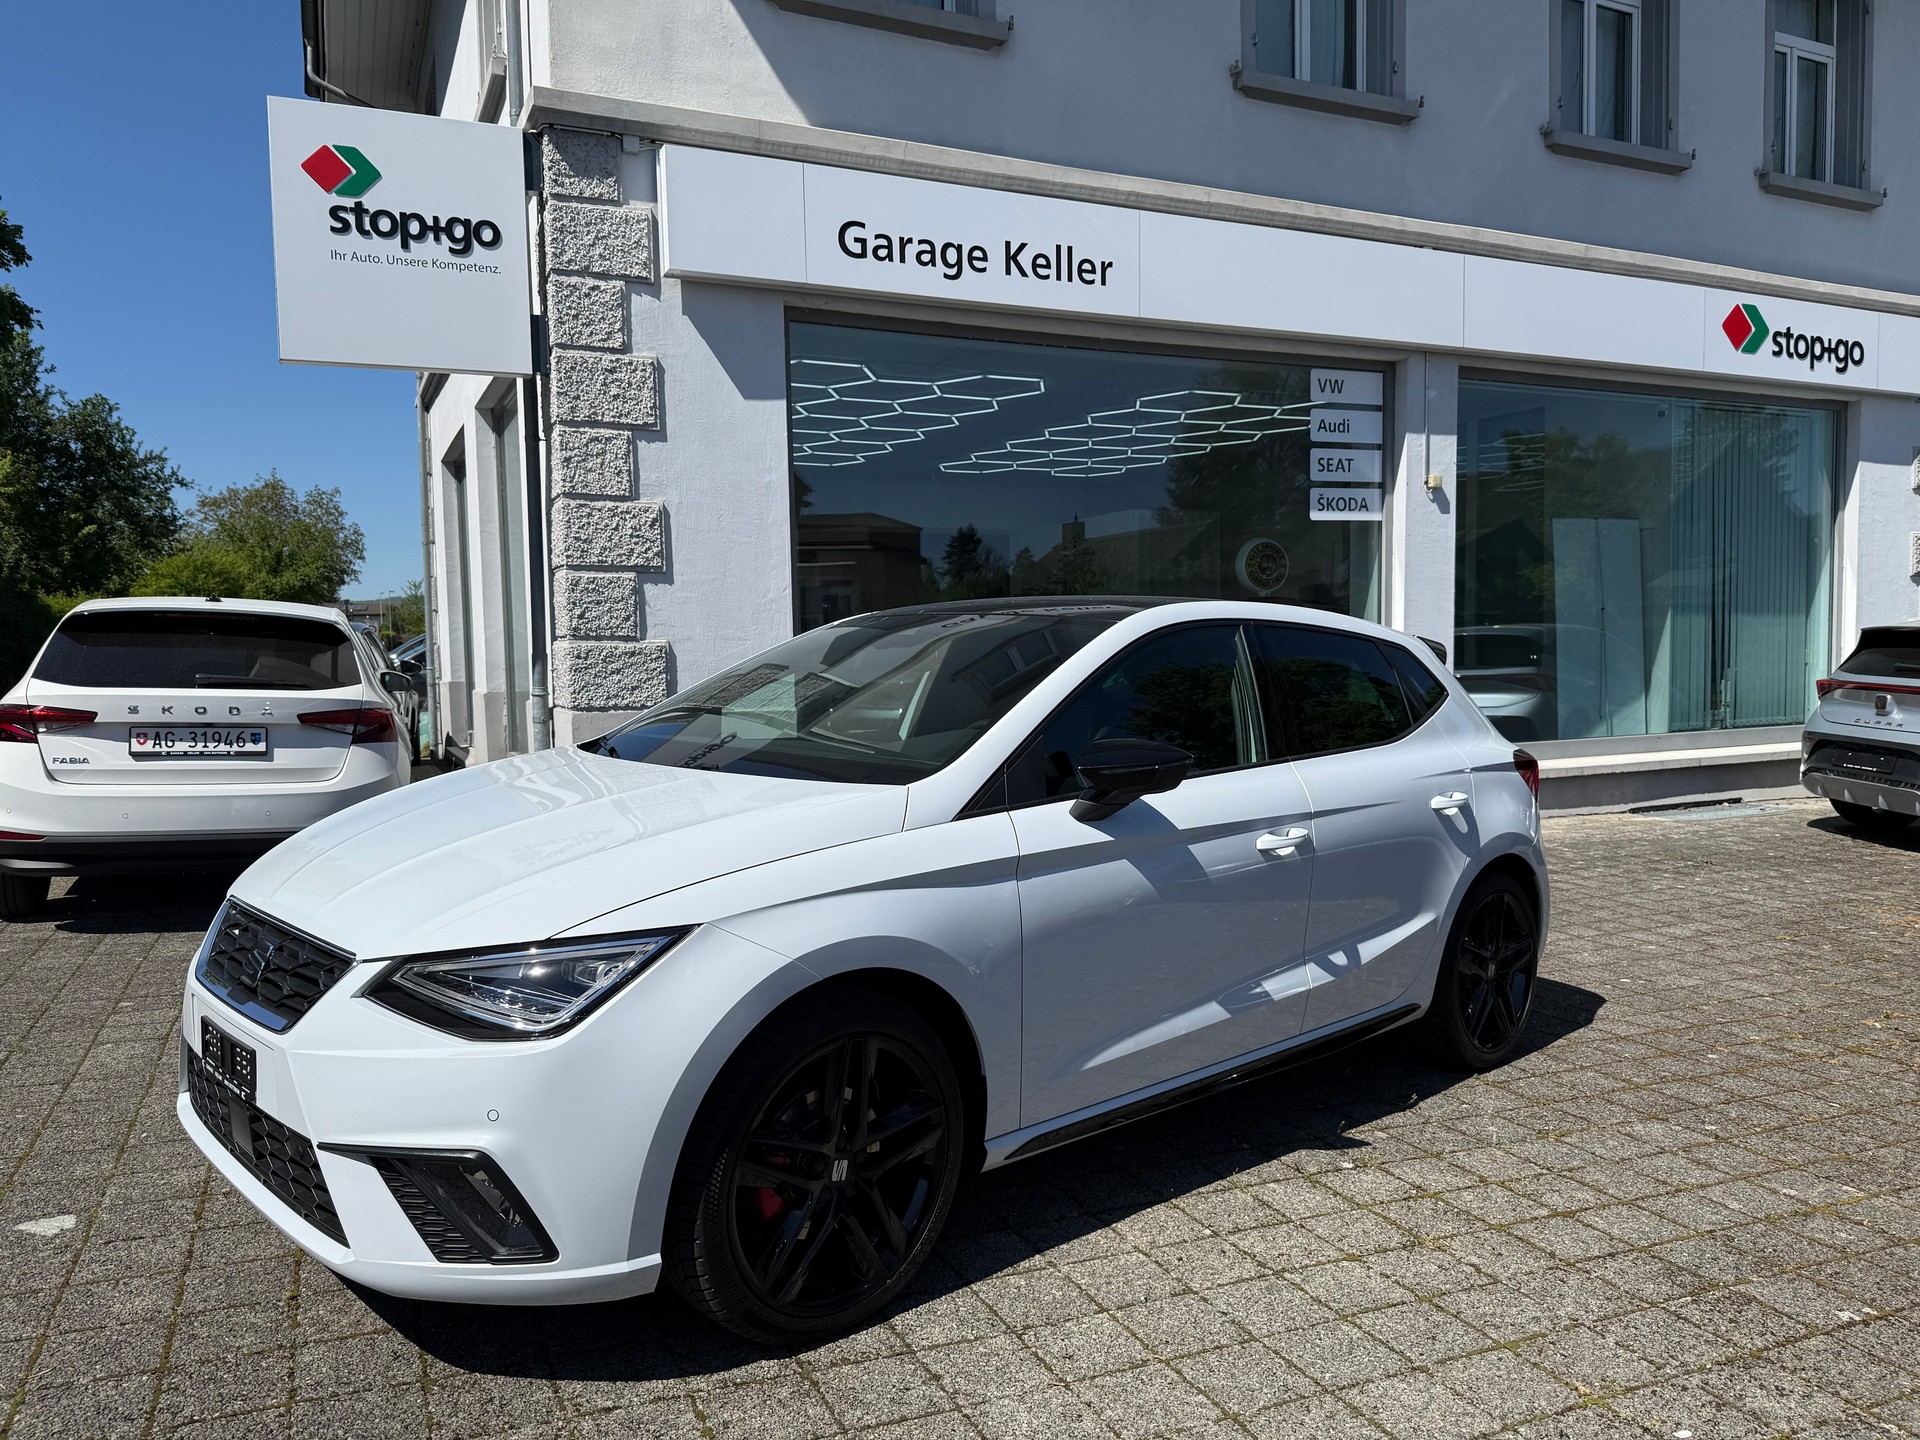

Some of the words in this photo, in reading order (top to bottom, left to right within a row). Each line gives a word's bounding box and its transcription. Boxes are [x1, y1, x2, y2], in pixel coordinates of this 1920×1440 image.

[328, 200, 502, 255] stop+go
[330, 249, 347, 262] Ihr
[350, 251, 383, 265] Auto.
[386, 254, 428, 269] Unsere
[431, 258, 502, 275] Kompetenz.
[837, 220, 989, 281] Garage
[1004, 240, 1113, 286] Keller
[1771, 326, 1865, 373] stop+go
[1317, 378, 1344, 394] VW
[1317, 418, 1350, 434] Audi
[1317, 457, 1354, 473] SEAT
[1317, 493, 1369, 512] ŠKODA
[52, 757, 91, 765] FABIA
